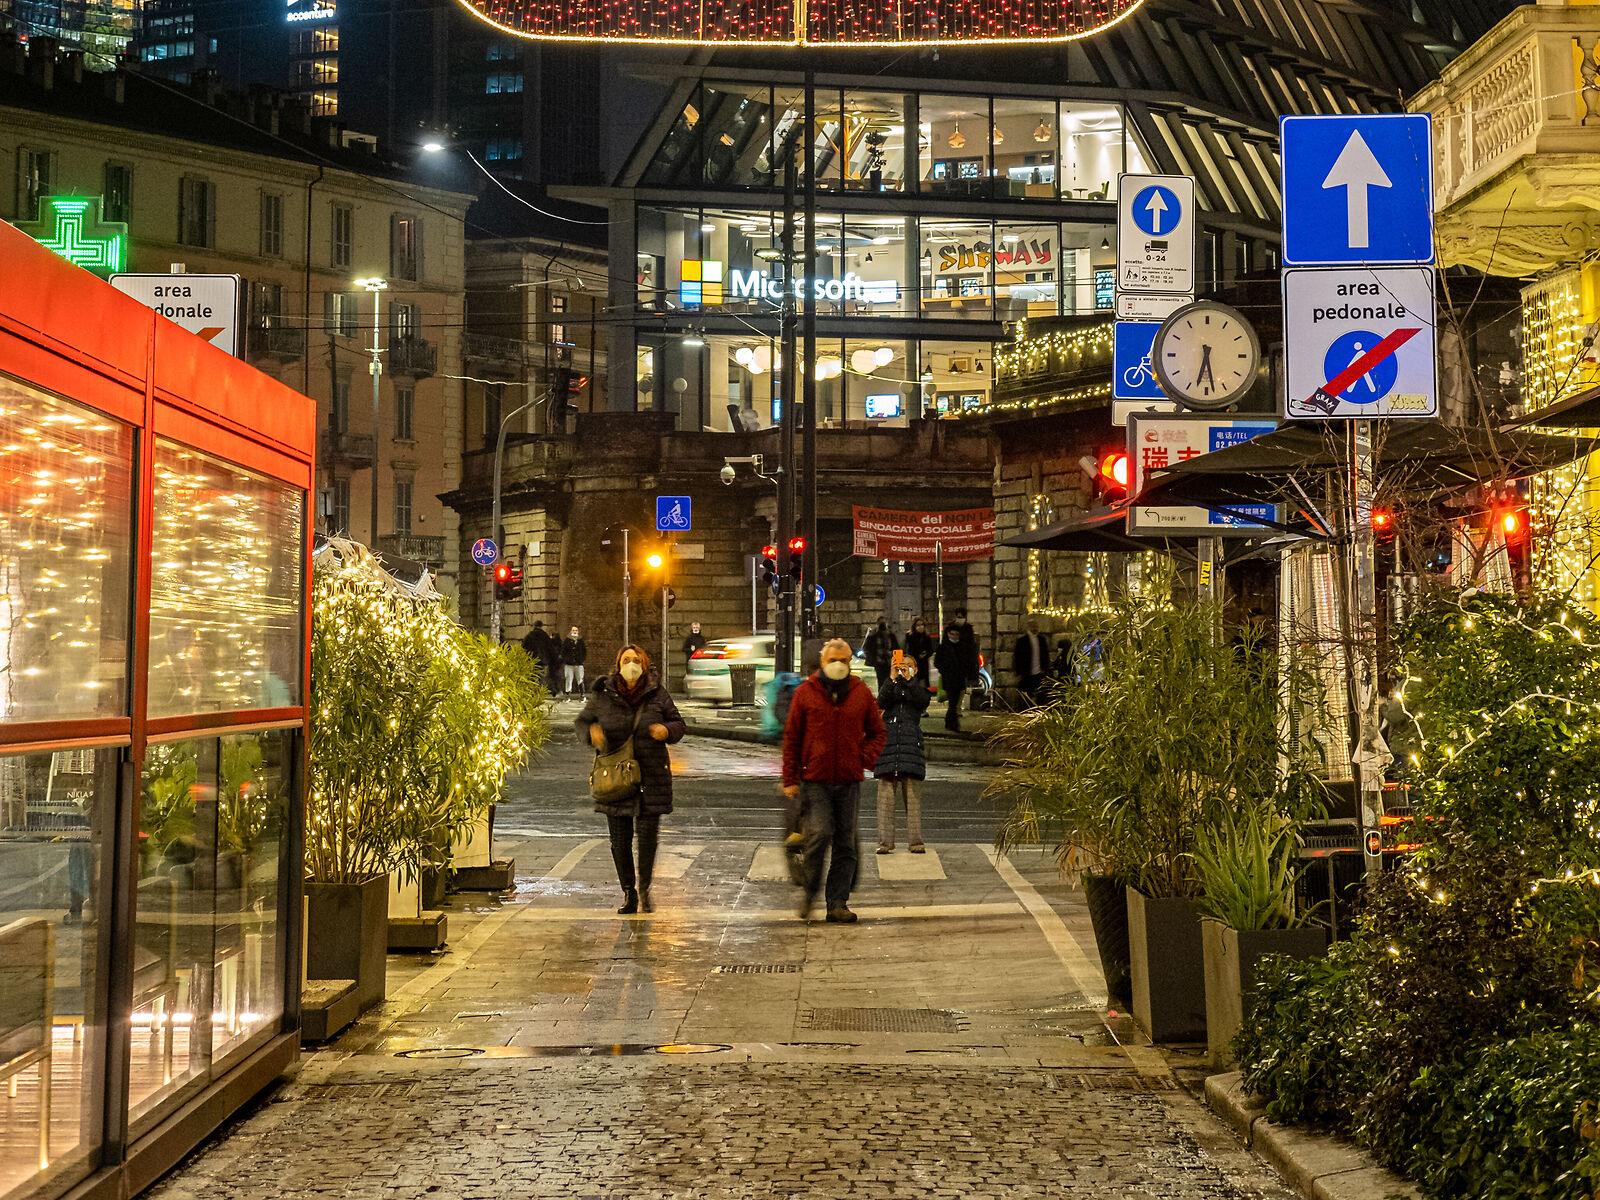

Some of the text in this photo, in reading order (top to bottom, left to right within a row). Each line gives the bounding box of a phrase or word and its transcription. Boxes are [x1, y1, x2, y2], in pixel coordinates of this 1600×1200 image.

[287, 6, 334, 22] accenture
[154, 286, 192, 297] area
[731, 269, 863, 300] Micosoft
[1336, 283, 1380, 296] area
[155, 303, 212, 318] donale
[1313, 302, 1406, 323] pedonale
[1315, 393, 1335, 409] GRAM
[858, 509, 918, 524] CAMERA
[921, 514, 942, 525] del
[945, 512, 976, 523] NON
[859, 520, 922, 534] SINDACATO
[924, 524, 973, 534] SOCIALE
